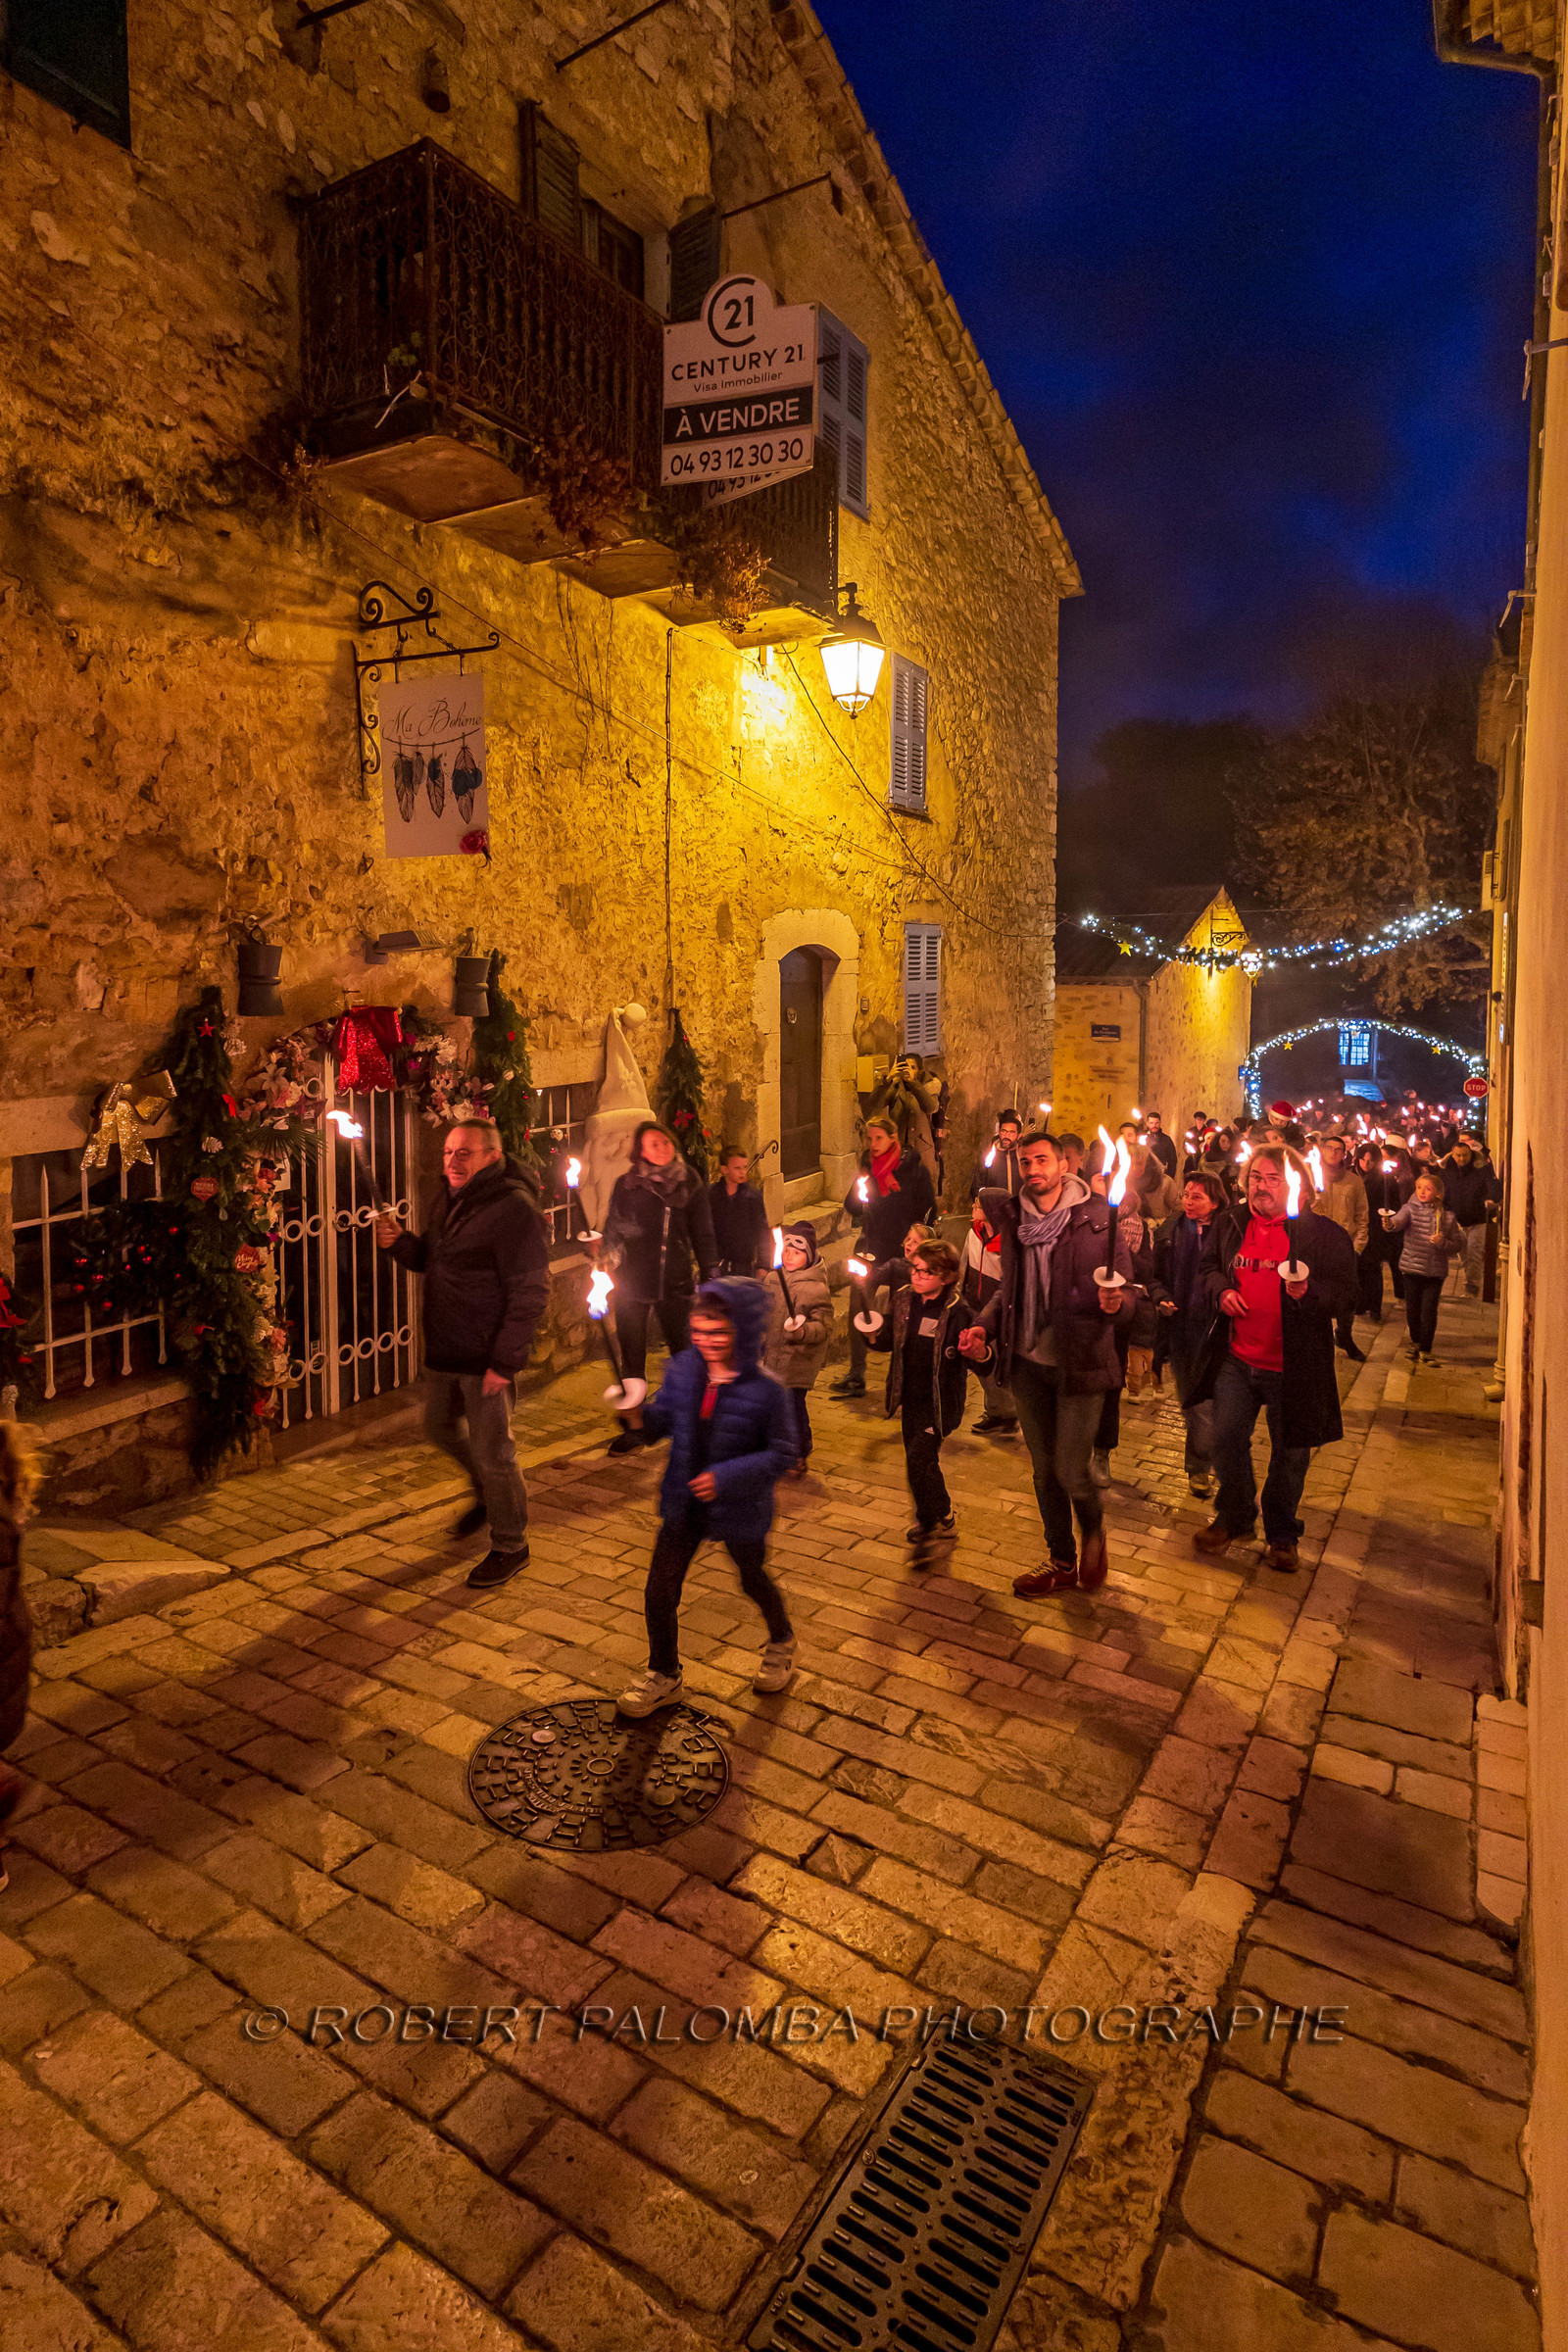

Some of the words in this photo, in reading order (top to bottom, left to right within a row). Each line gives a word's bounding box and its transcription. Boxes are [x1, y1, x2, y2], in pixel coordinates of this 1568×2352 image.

[724, 295, 754, 331] 21
[671, 348, 777, 381] CENTURY
[784, 344, 804, 364] 21
[694, 381, 717, 393] Visa
[721, 370, 783, 389] Immobilier
[675, 408, 693, 438] À
[699, 397, 800, 433] VENDRE
[670, 453, 695, 476] 04
[699, 450, 721, 471] 93
[726, 447, 744, 469] 12
[748, 442, 774, 466] 30
[778, 437, 804, 462] 30
[382, 702, 418, 739] Ma
